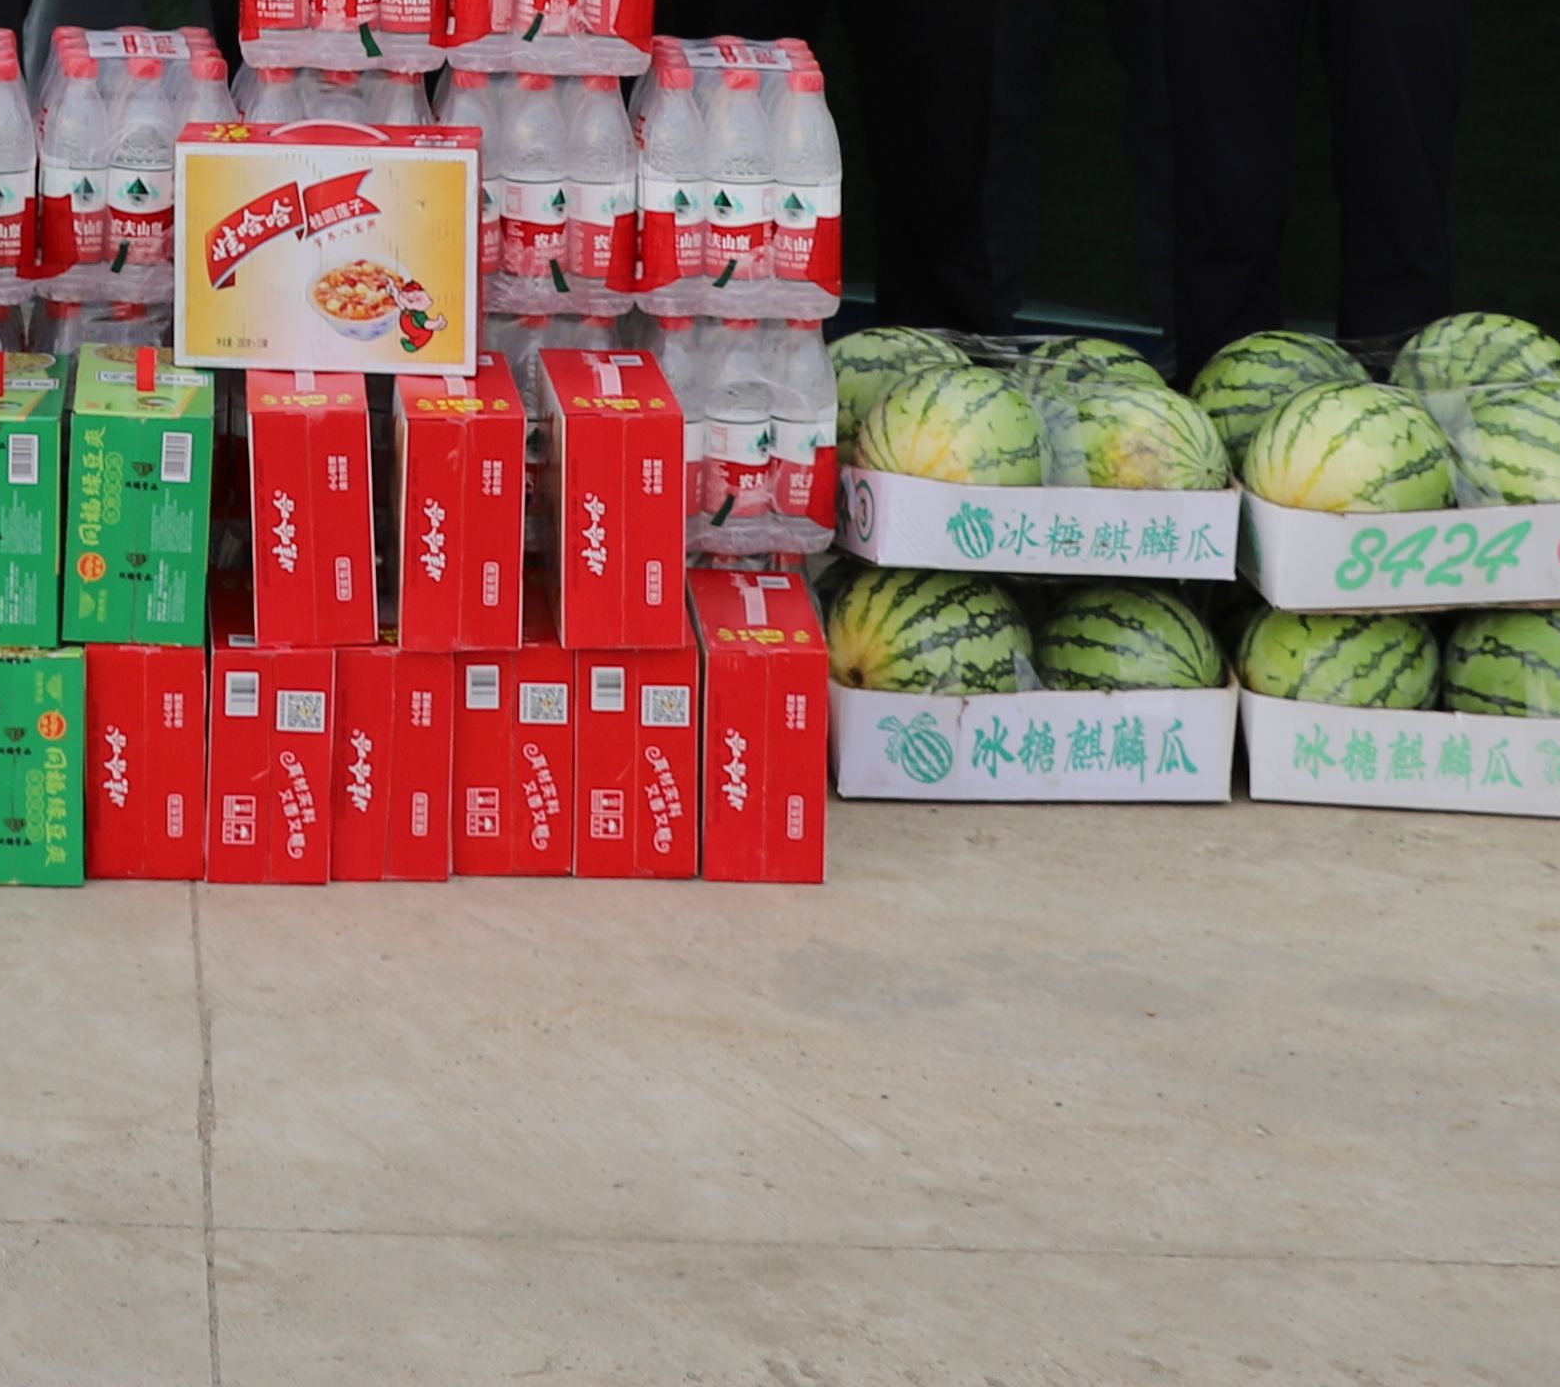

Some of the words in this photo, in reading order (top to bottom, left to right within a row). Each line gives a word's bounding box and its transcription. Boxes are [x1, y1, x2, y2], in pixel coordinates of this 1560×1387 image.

[110, 219, 165, 238] 农夫山泉
[213, 198, 294, 262] 娃哈哈
[309, 199, 365, 231] 桂圆莲子
[272, 491, 299, 574] 娃哈哈
[420, 500, 447, 584] 娃哈哈
[581, 494, 609, 577] 娃哈哈
[998, 511, 1226, 565] 冰糖麒麟瓜
[1334, 520, 1533, 591] 8424
[103, 727, 130, 808] 娃哈哈
[347, 730, 374, 813] 娃哈哈
[721, 730, 749, 813] 娃哈哈
[970, 713, 1199, 784] 冰糖麒麟瓜
[1293, 723, 1523, 792] 冰糖麒麟瓜
